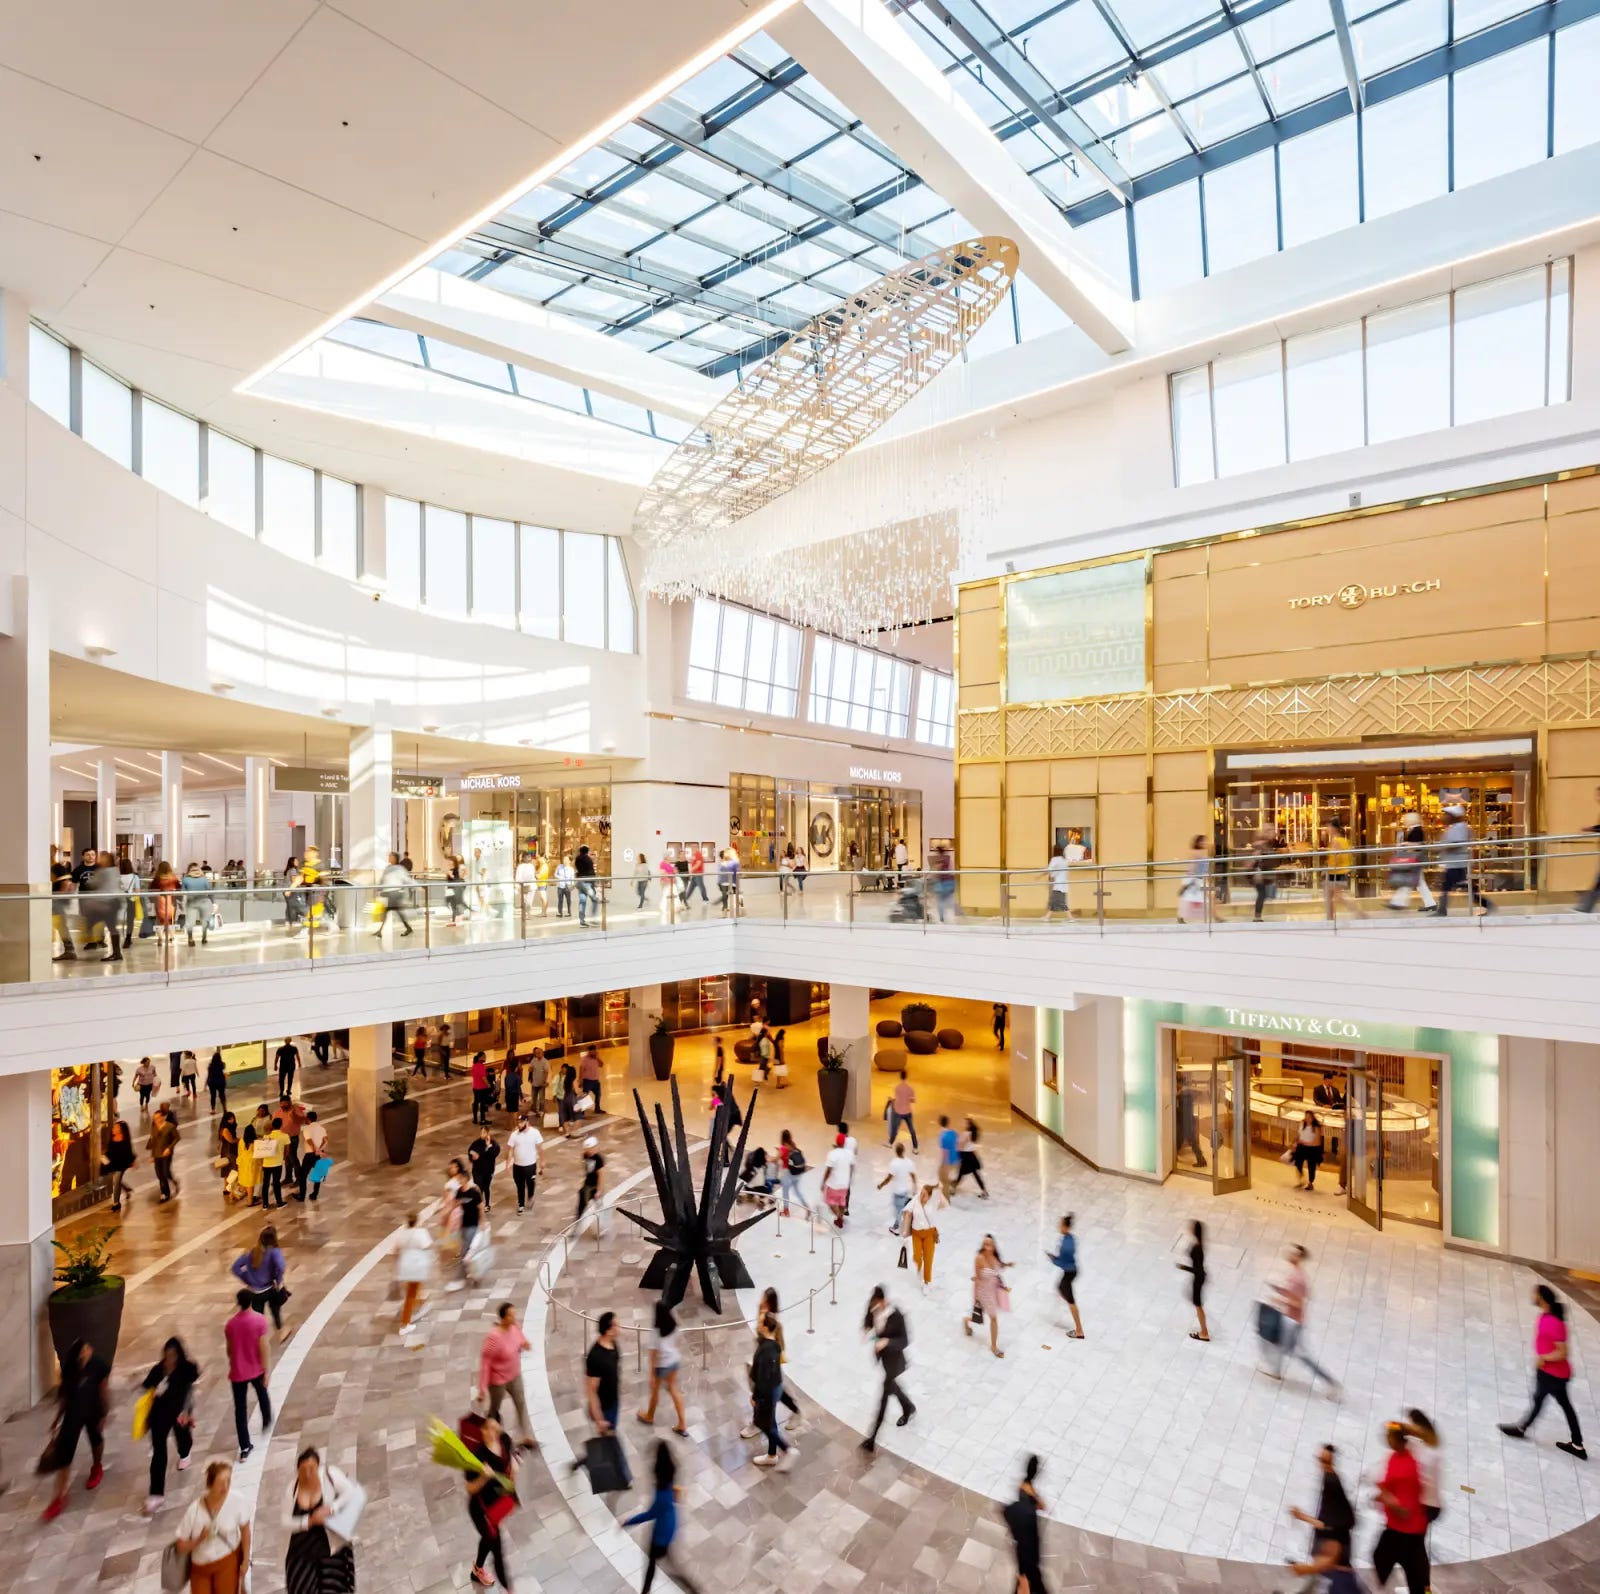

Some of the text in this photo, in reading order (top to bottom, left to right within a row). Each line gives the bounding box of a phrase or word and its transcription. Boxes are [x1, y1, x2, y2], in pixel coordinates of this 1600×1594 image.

[1288, 578, 1441, 609] TORY BURCH
[460, 776, 521, 790] MICHAEL KORS
[849, 767, 902, 783] MICHAEL KORS
[1225, 1008, 1307, 1032] TIFFANY
[1308, 1018, 1323, 1035] &
